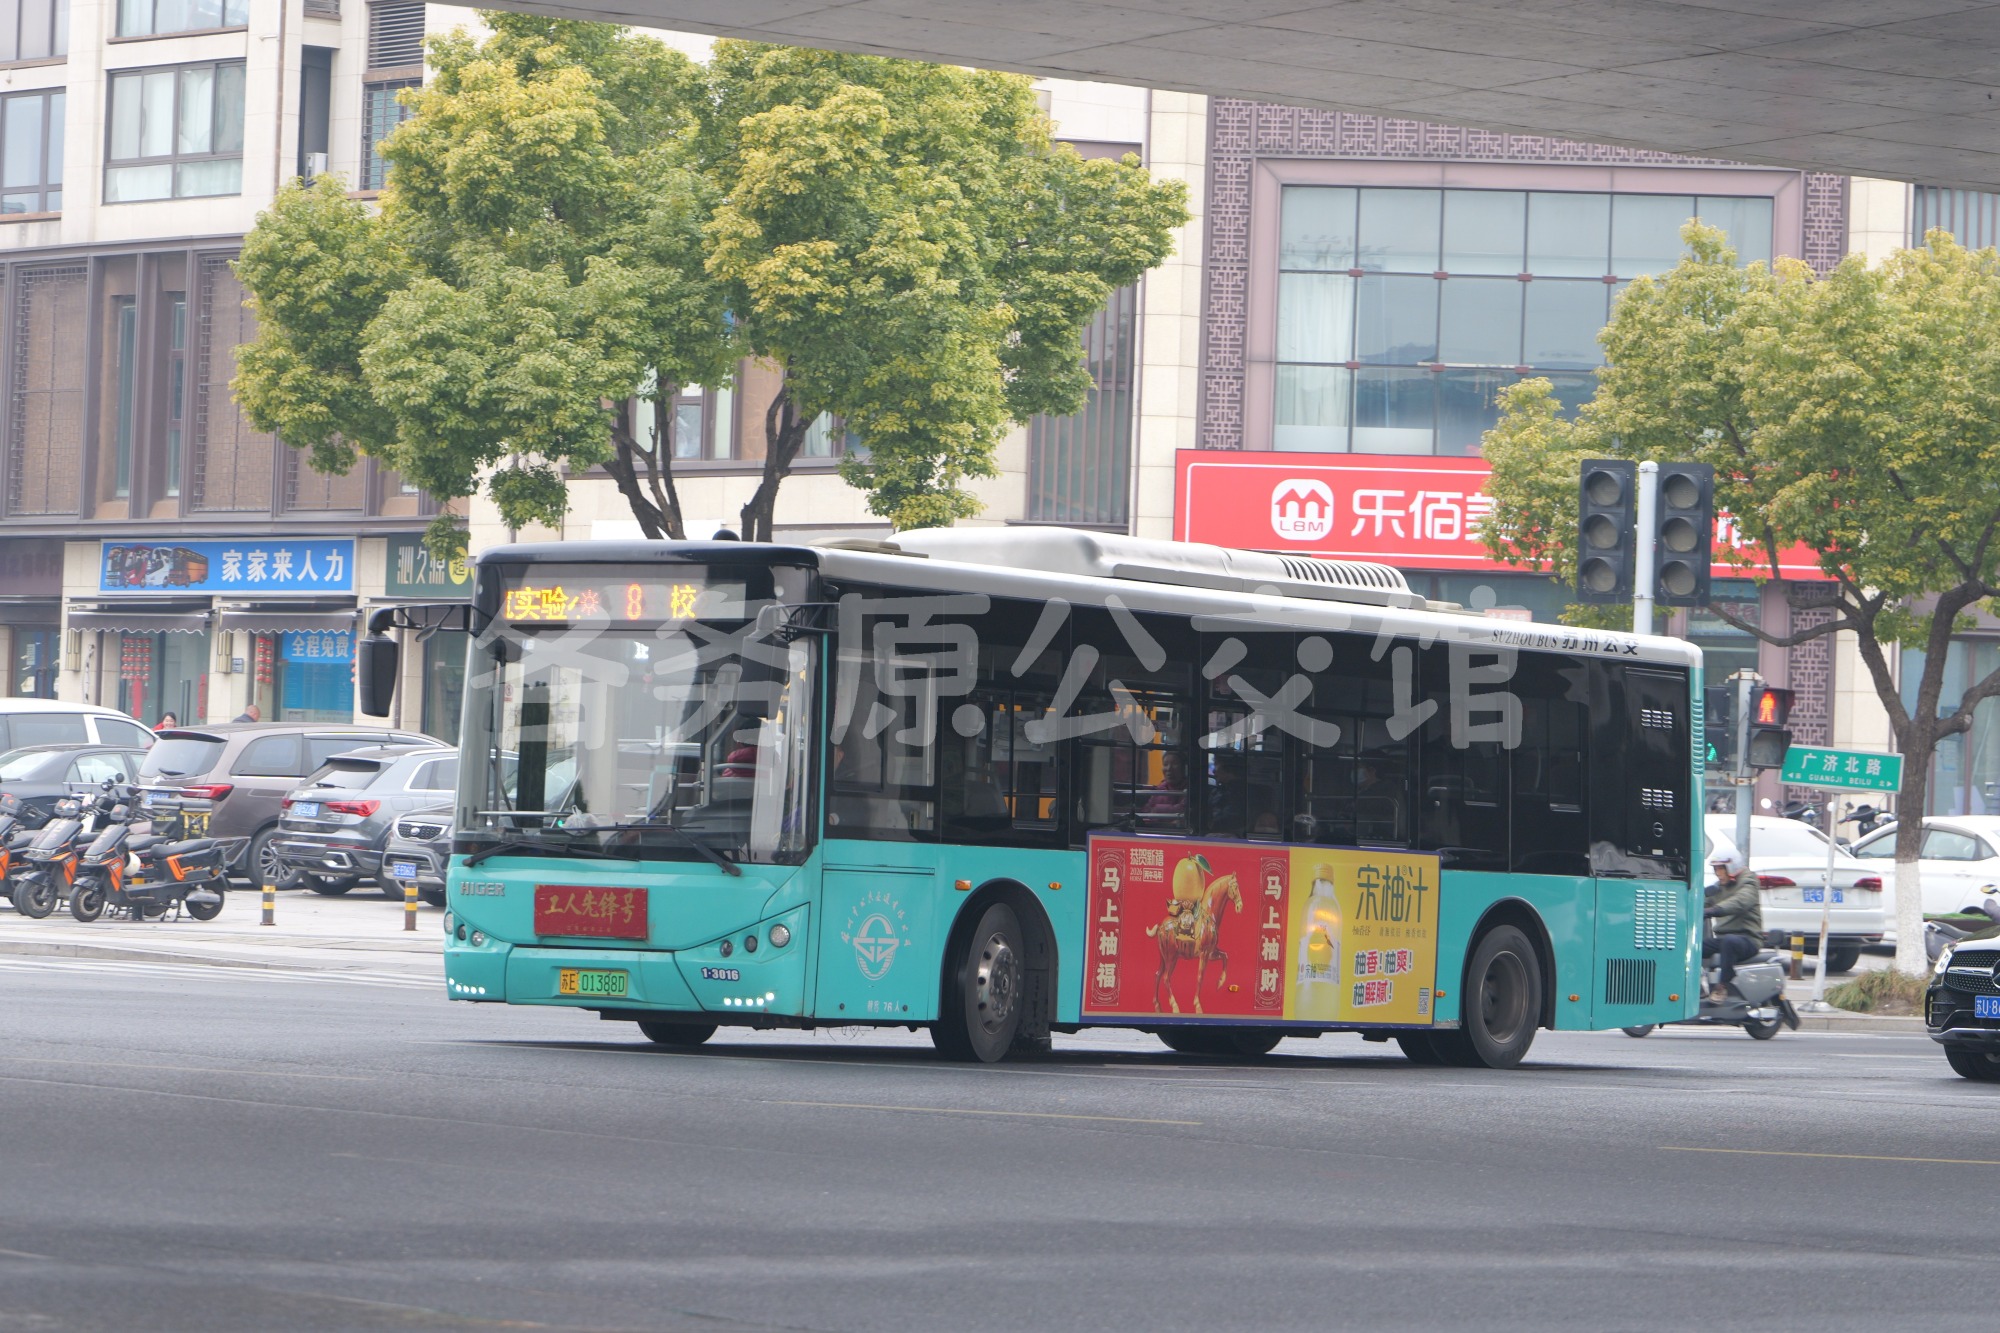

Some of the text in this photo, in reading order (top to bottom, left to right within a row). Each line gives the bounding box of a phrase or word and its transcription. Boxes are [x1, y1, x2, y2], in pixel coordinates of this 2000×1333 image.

[1279, 521, 1325, 533] LBM
[222, 549, 345, 582] 家家来人力
[626, 584, 643, 620] 8
[291, 635, 349, 657] 全程免费
[1492, 629, 1559, 649] SUZHOU BUS
[1561, 631, 1640, 656] 苏州公交
[1801, 753, 1881, 776] 广济北路
[1809, 773, 1843, 783] GUANGJI
[460, 881, 506, 897] HIGER
[544, 890, 635, 924] 工人先锋号
